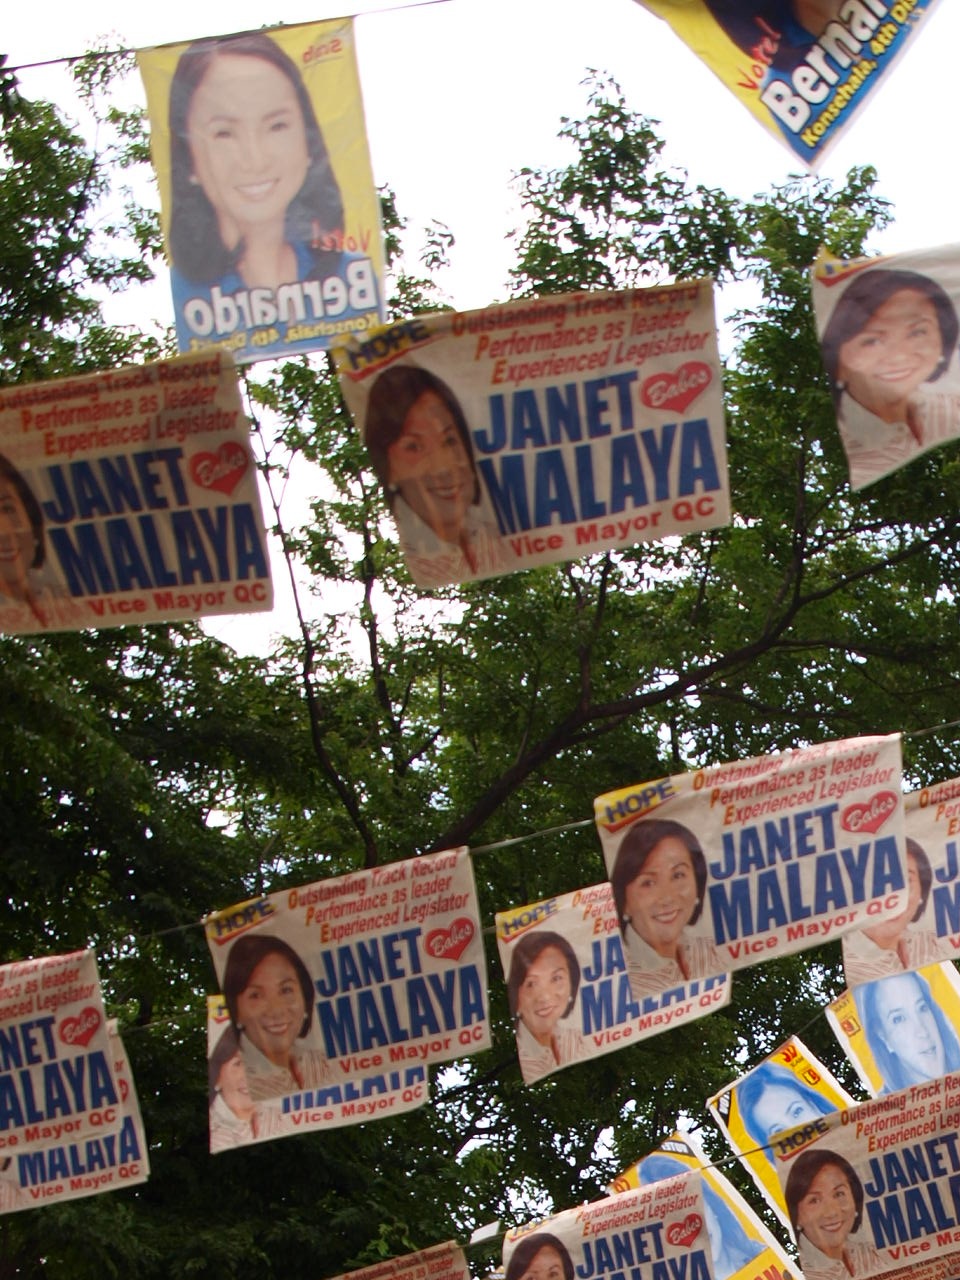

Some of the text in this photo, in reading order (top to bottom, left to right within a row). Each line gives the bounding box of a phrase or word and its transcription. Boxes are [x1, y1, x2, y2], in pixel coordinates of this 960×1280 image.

[801, 22, 898, 148] Konsehala, 4th
[344, 320, 432, 372] HOPE
[491, 329, 712, 386] Experienced Legislator
[473, 368, 711, 455] JANET Babes
[42, 447, 191, 525] JANET
[478, 419, 722, 539] MALAYA
[48, 502, 269, 599] MALAYA
[509, 496, 716, 559] Vice Mayor QC
[86, 581, 268, 618] Vice Mayor QC
[604, 779, 676, 823] HOPE
[708, 798, 896, 880] JANET Babes
[213, 899, 274, 937] HOPE
[708, 836, 906, 947] MALAYA
[727, 895, 899, 960] Vice Mayor QC
[316, 923, 474, 998] JANET Babes
[316, 964, 486, 1061] MALAYA
[17, 1116, 142, 1188] MALAYA
[776, 1116, 829, 1155] HOPE
[576, 1221, 665, 1280] JANET
